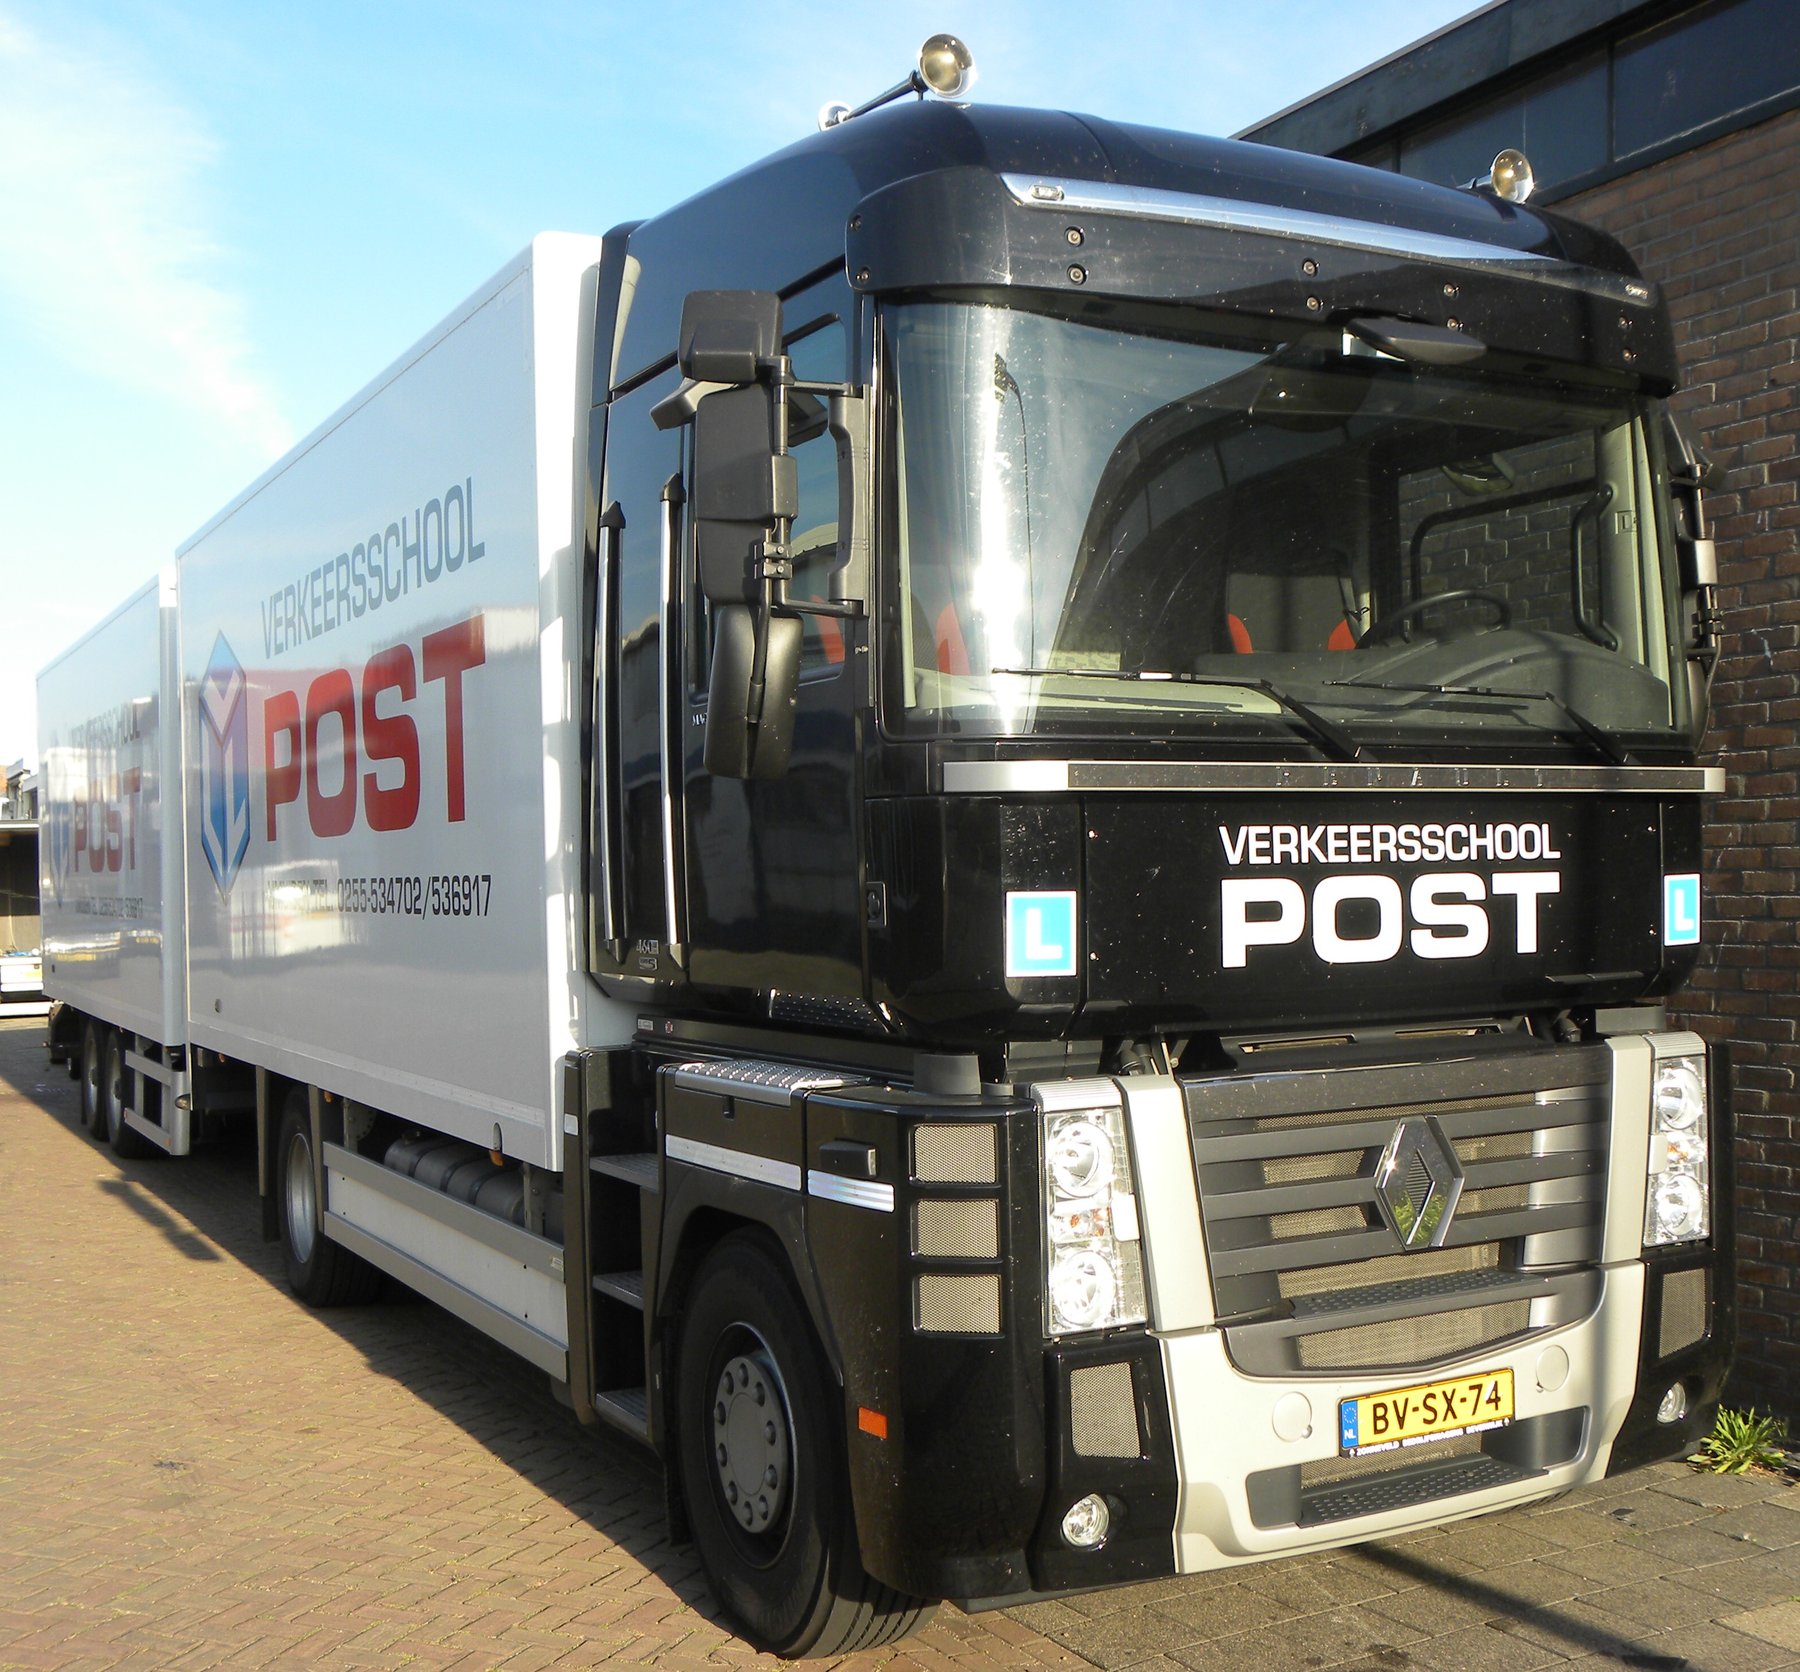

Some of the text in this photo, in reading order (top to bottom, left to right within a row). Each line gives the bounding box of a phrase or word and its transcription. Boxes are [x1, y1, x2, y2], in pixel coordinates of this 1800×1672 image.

[261, 476, 485, 659] VERKEERSSCHOOL
[263, 612, 486, 842] POST
[73, 766, 141, 873] POST
[1218, 823, 1562, 865] VERKEERSSCHOOL
[337, 875, 492, 920] 0255-534702/536917
[1221, 871, 1561, 969] POST
[1674, 888, 1695, 932] L
[1025, 908, 1063, 960] L
[1343, 1428, 1357, 1440] NL
[1372, 1379, 1502, 1436] BV-SX-74
